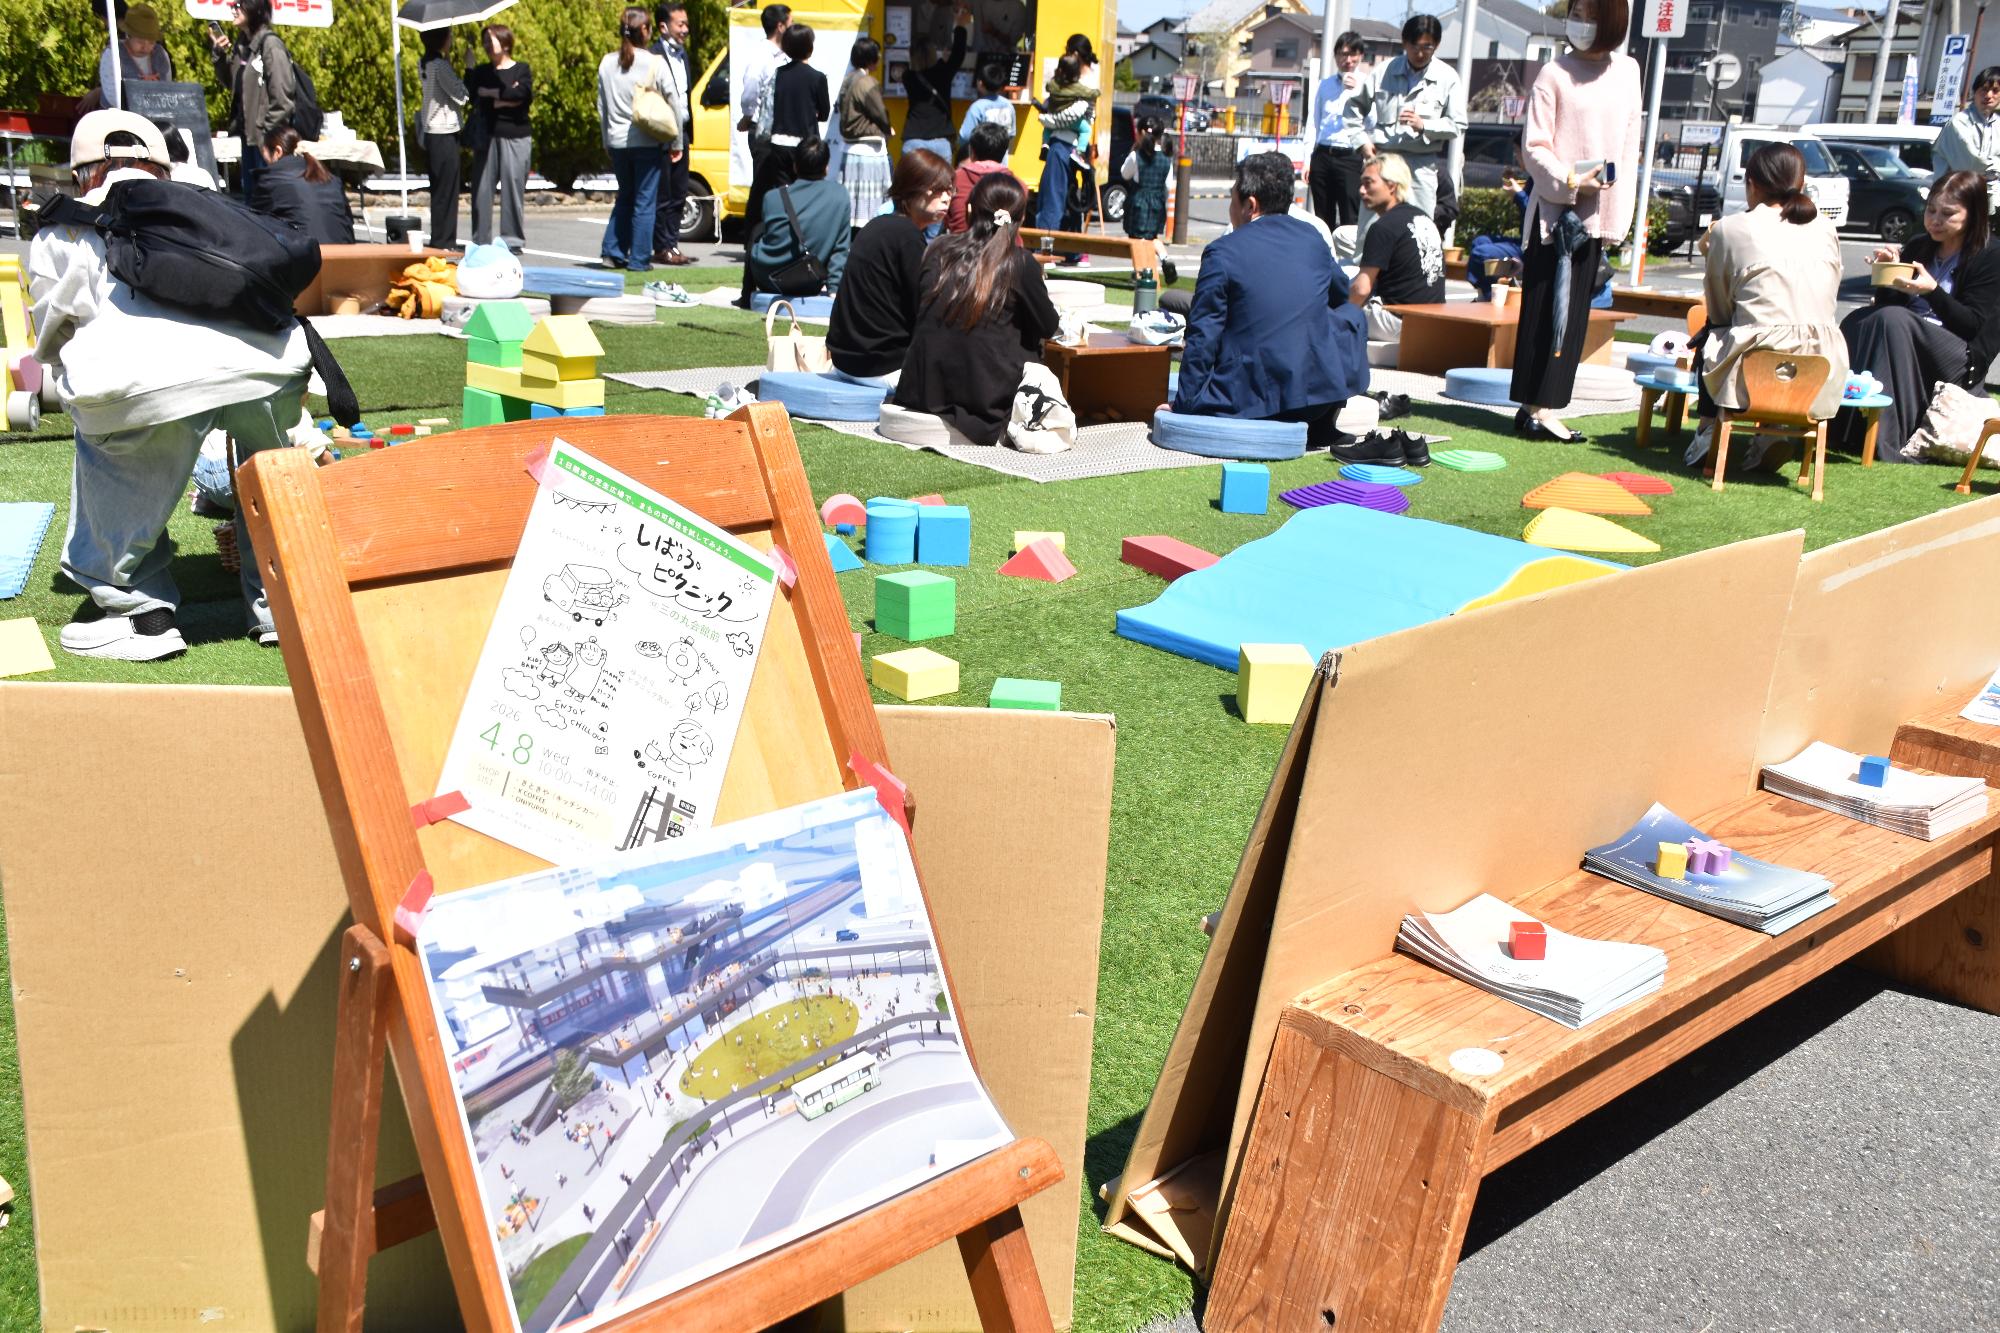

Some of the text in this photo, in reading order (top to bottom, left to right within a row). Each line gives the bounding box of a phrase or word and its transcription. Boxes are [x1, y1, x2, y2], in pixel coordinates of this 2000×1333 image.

[1656, 0, 1674, 32] 注意
[1948, 39, 1963, 55] P
[1944, 75, 1958, 110] 駐車場
[636, 522, 702, 571] しばふ
[653, 563, 734, 616] ピクニック
[521, 661, 539, 670] BABY
[527, 656, 543, 665] KIDS
[699, 652, 720, 675] DONUT
[602, 669, 621, 683] MAMA
[602, 679, 617, 692] PAPA
[490, 700, 521, 722] 2026
[554, 700, 586, 716] ENJOY
[480, 721, 534, 765] 4.8
[543, 747, 571, 766] wed
[647, 770, 677, 788] COFFEE
